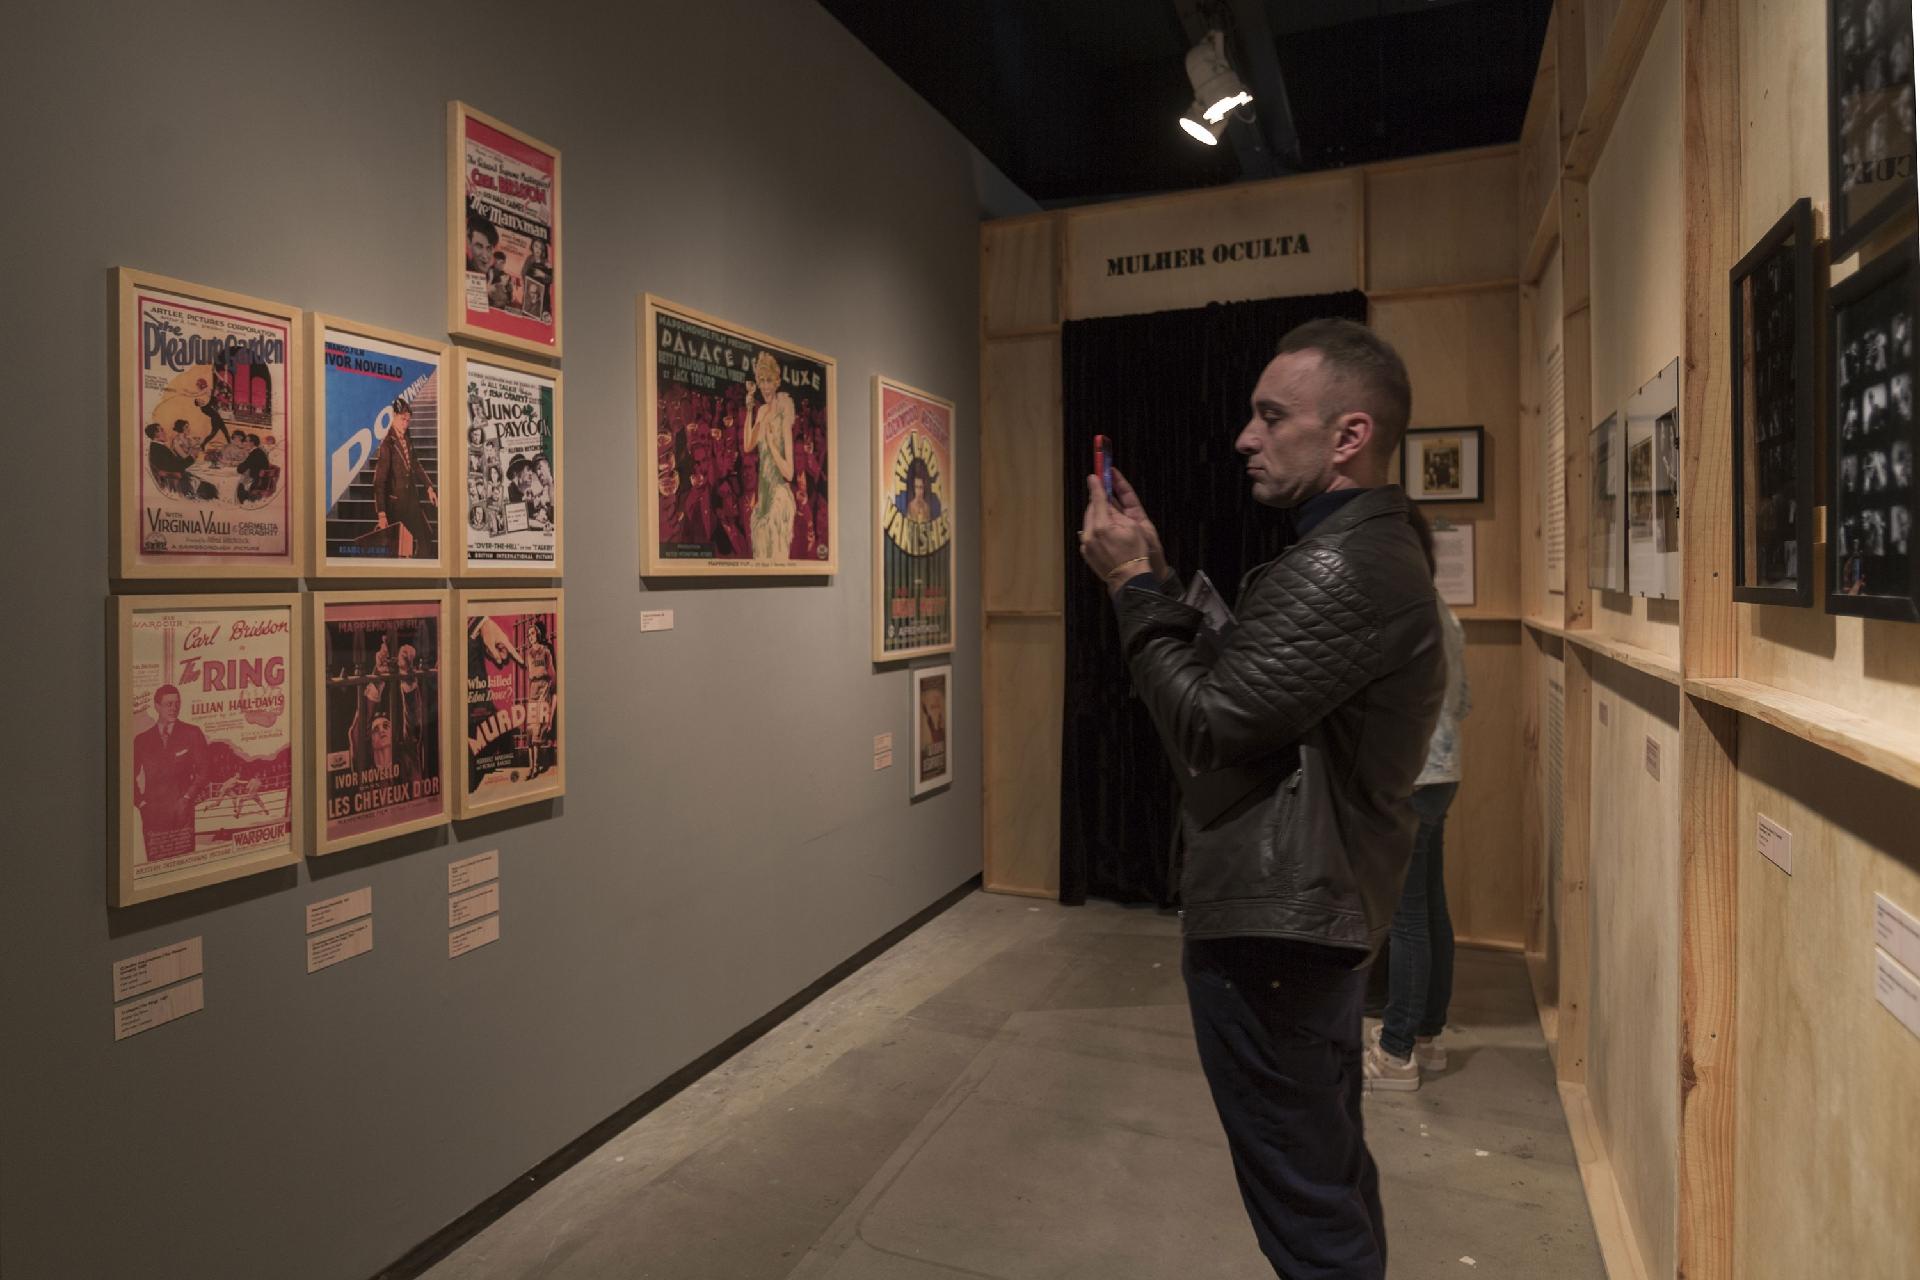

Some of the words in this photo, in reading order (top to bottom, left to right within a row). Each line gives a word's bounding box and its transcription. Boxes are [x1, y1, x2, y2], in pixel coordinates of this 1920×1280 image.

[471, 195, 489, 217] The
[489, 206, 548, 240] Manxman
[1107, 248, 1206, 276] MULHER
[1212, 233, 1311, 264] OCULTA
[151, 307, 183, 319] ARTLEE
[187, 313, 225, 328] PICTURES
[227, 322, 277, 338] CORPORATION
[326, 353, 352, 369] IVOR
[355, 358, 403, 378] NOVELLO
[661, 328, 735, 367] PALACE
[782, 365, 821, 391] LUXE
[673, 367, 688, 384] JACK
[691, 371, 716, 389] TREVOR
[480, 399, 523, 421] JUNO
[494, 415, 553, 450] PAYCOCK
[146, 506, 202, 535] VIRGINIA
[199, 510, 231, 535] VALLI
[183, 625, 221, 651] Carl
[228, 619, 288, 642] Brisson
[202, 656, 285, 692] RING
[467, 675, 487, 690] Who
[488, 674, 514, 689] killed
[192, 701, 225, 715] LILIAN
[228, 694, 285, 711] HALL-DAVIS
[335, 771, 359, 789] IVOR
[361, 763, 400, 785] NOVELLO
[328, 796, 352, 819] LES
[353, 782, 410, 813] CHEVEUX
[412, 776, 440, 800] D'OR
[233, 824, 285, 847] WARDOUR
